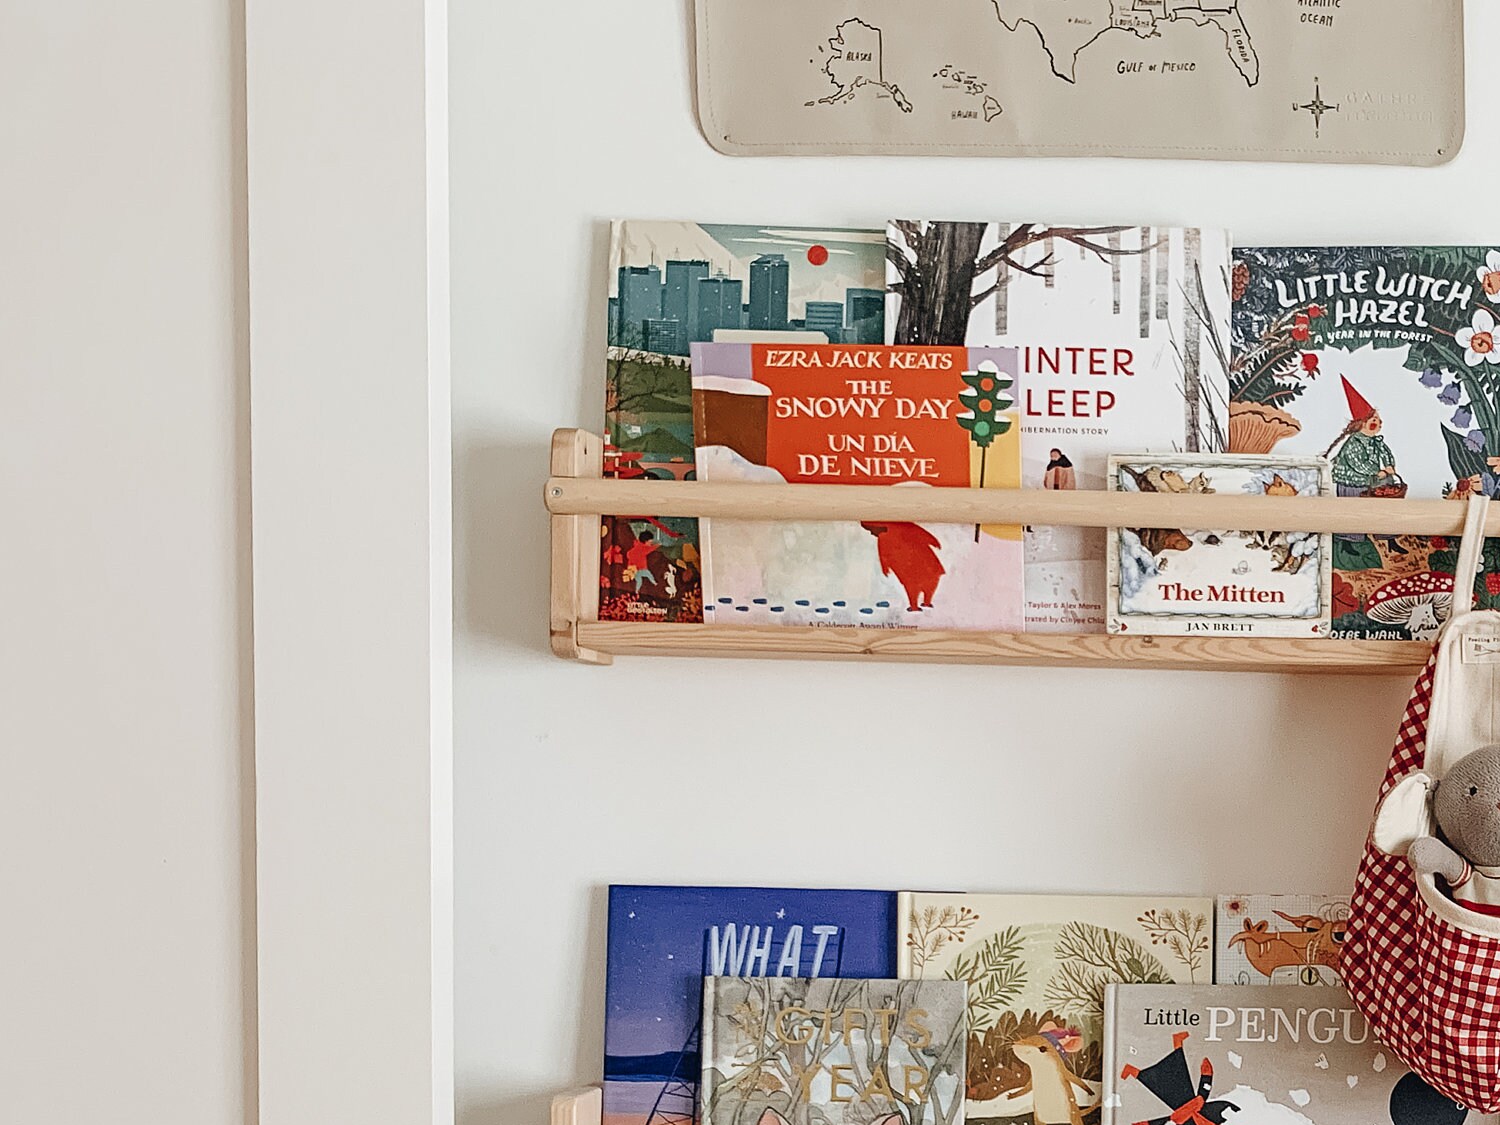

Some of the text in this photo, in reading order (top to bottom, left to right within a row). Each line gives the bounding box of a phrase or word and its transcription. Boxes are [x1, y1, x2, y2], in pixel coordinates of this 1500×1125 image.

[1300, 12, 1334, 27] OCEAN
[1231, 28, 1250, 63] FLORIDA
[1117, 60, 1144, 74] GULF
[1161, 62, 1197, 74] MEXICO
[1275, 266, 1473, 310] LITTLE WITCH
[1335, 299, 1429, 328] HAZEL
[1314, 330, 1434, 344] A YEAR IN THE FOREST
[765, 350, 953, 370] EZRA JACK KEATS
[1025, 346, 1135, 376] INTER
[845, 380, 893, 395] THE
[776, 397, 955, 420] SNOWY DAY
[1026, 389, 1116, 418] LEEP
[1081, 427, 1109, 435] STORY
[828, 432, 915, 453] UN DÍA
[798, 454, 940, 478] DE NIEVE
[1158, 583, 1285, 603] The Mitten
[1028, 601, 1050, 610] Taylor
[1024, 615, 1047, 624] trated
[1049, 616, 1058, 625] by
[1186, 622, 1255, 632] JAN BRETT
[710, 922, 839, 978] WHAT
[774, 1006, 932, 1048] GIFTS
[1143, 1007, 1383, 1044] Little PENGU
[793, 1064, 930, 1104] YEAR
